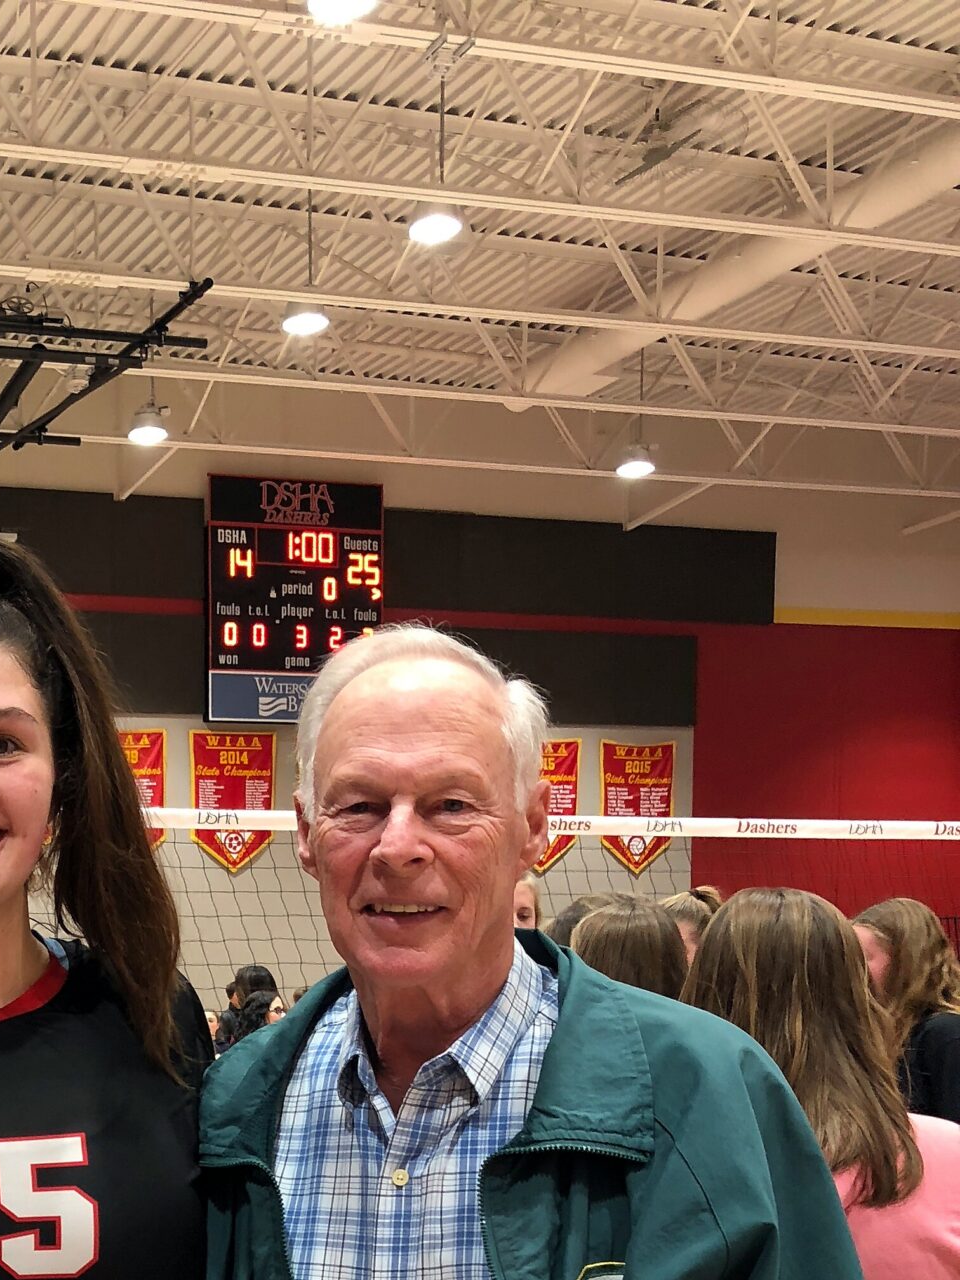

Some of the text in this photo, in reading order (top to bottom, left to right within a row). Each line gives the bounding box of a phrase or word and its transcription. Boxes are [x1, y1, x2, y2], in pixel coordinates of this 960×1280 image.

[260, 481, 334, 514] DSHA
[264, 509, 329, 525] DASHERS
[217, 529, 247, 544] DSHA
[344, 536, 378, 552] Guests
[288, 531, 334, 563] 1:00
[229, 547, 253, 578] 14
[347, 552, 380, 586] 25
[281, 582, 313, 597] period
[323, 577, 337, 601] 0
[216, 602, 240, 616] fouls
[281, 603, 314, 619] player
[353, 608, 377, 622] fouls
[223, 621, 237, 646] 0
[252, 623, 265, 646] 0
[296, 625, 307, 648] 3
[218, 654, 239, 665] won
[285, 656, 310, 669] game
[219, 751, 249, 765] 2014
[196, 765, 271, 779] State Champions
[625, 761, 651, 773] 2015
[605, 773, 671, 786] State Champions
[550, 818, 591, 831] shers
[736, 820, 797, 835] Dashers
